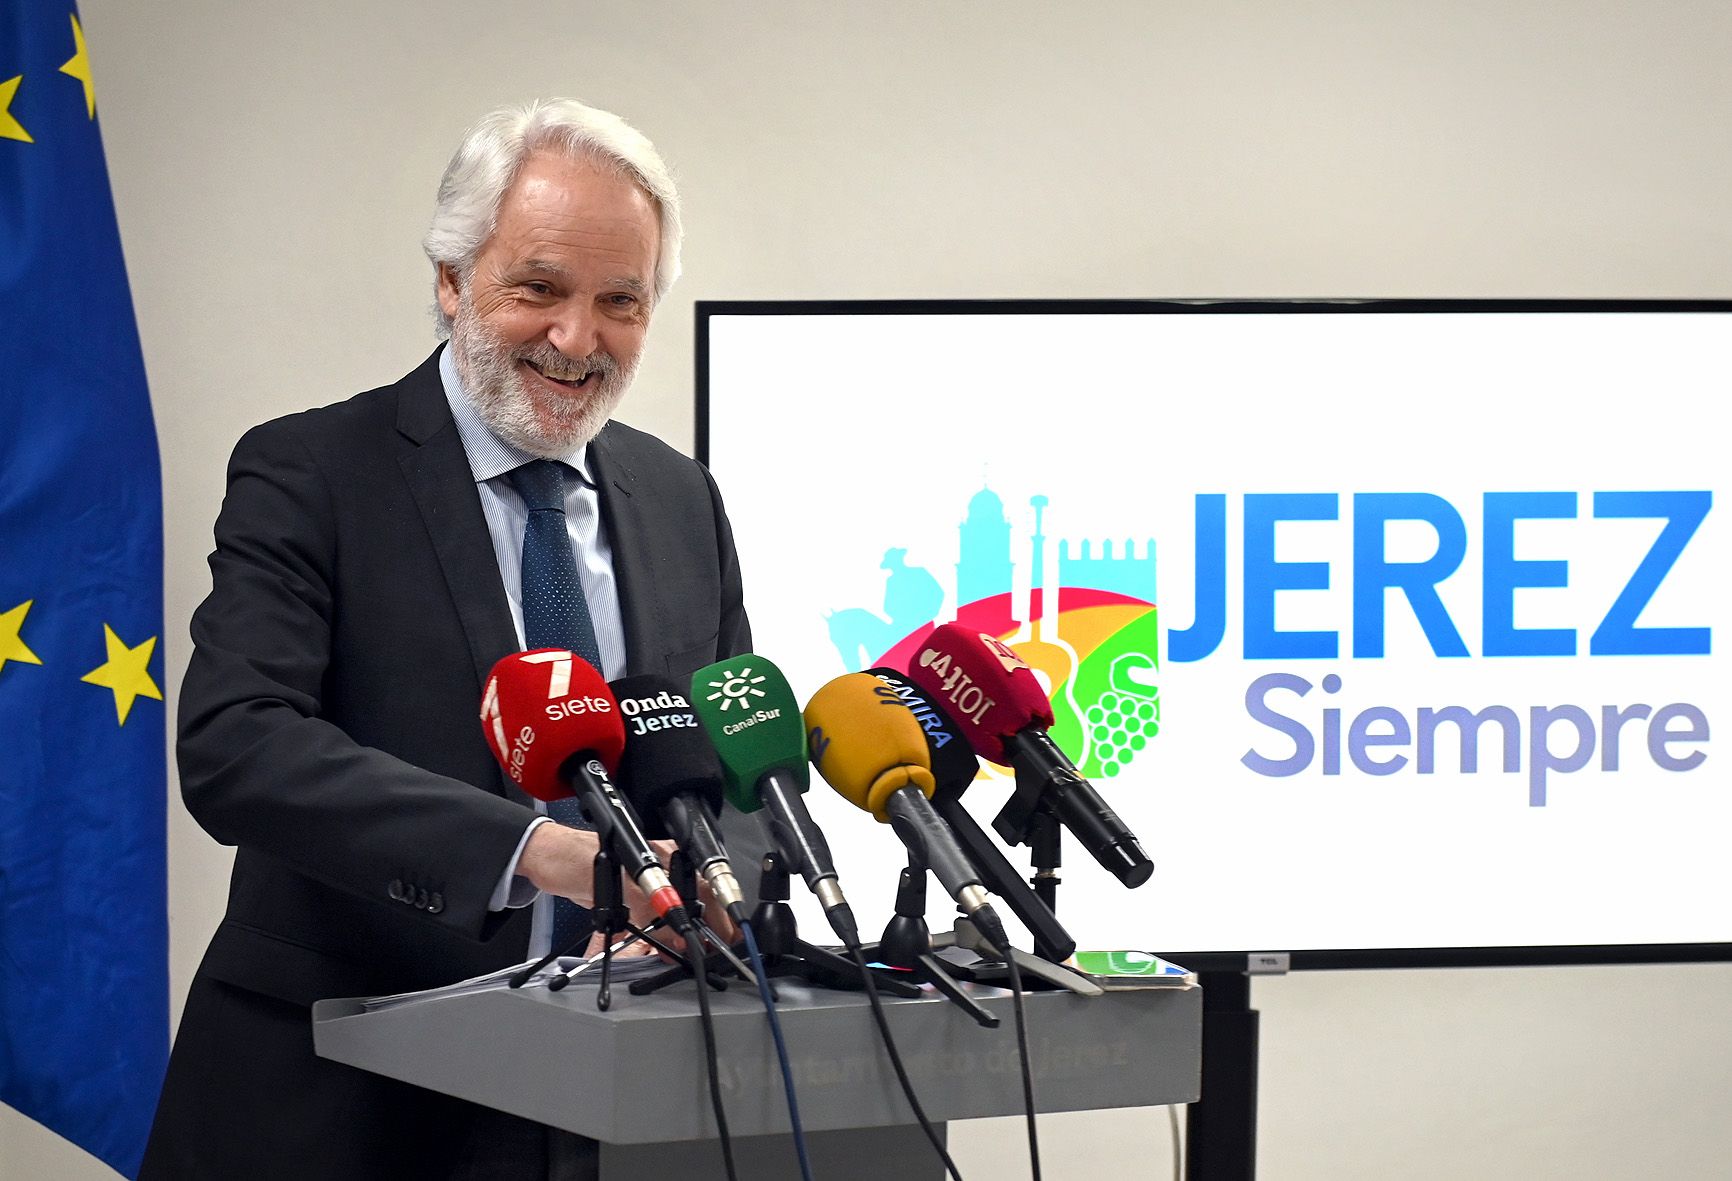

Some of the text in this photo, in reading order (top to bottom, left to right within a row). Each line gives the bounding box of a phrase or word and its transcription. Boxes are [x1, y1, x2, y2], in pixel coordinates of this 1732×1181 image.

[1168, 491, 1713, 662] JEREZ
[519, 651, 573, 700] 7
[545, 695, 611, 721] siete
[620, 691, 690, 716] Onda
[630, 712, 698, 736] Jerez
[510, 725, 536, 783] siete
[1240, 672, 1711, 807] Siempre
